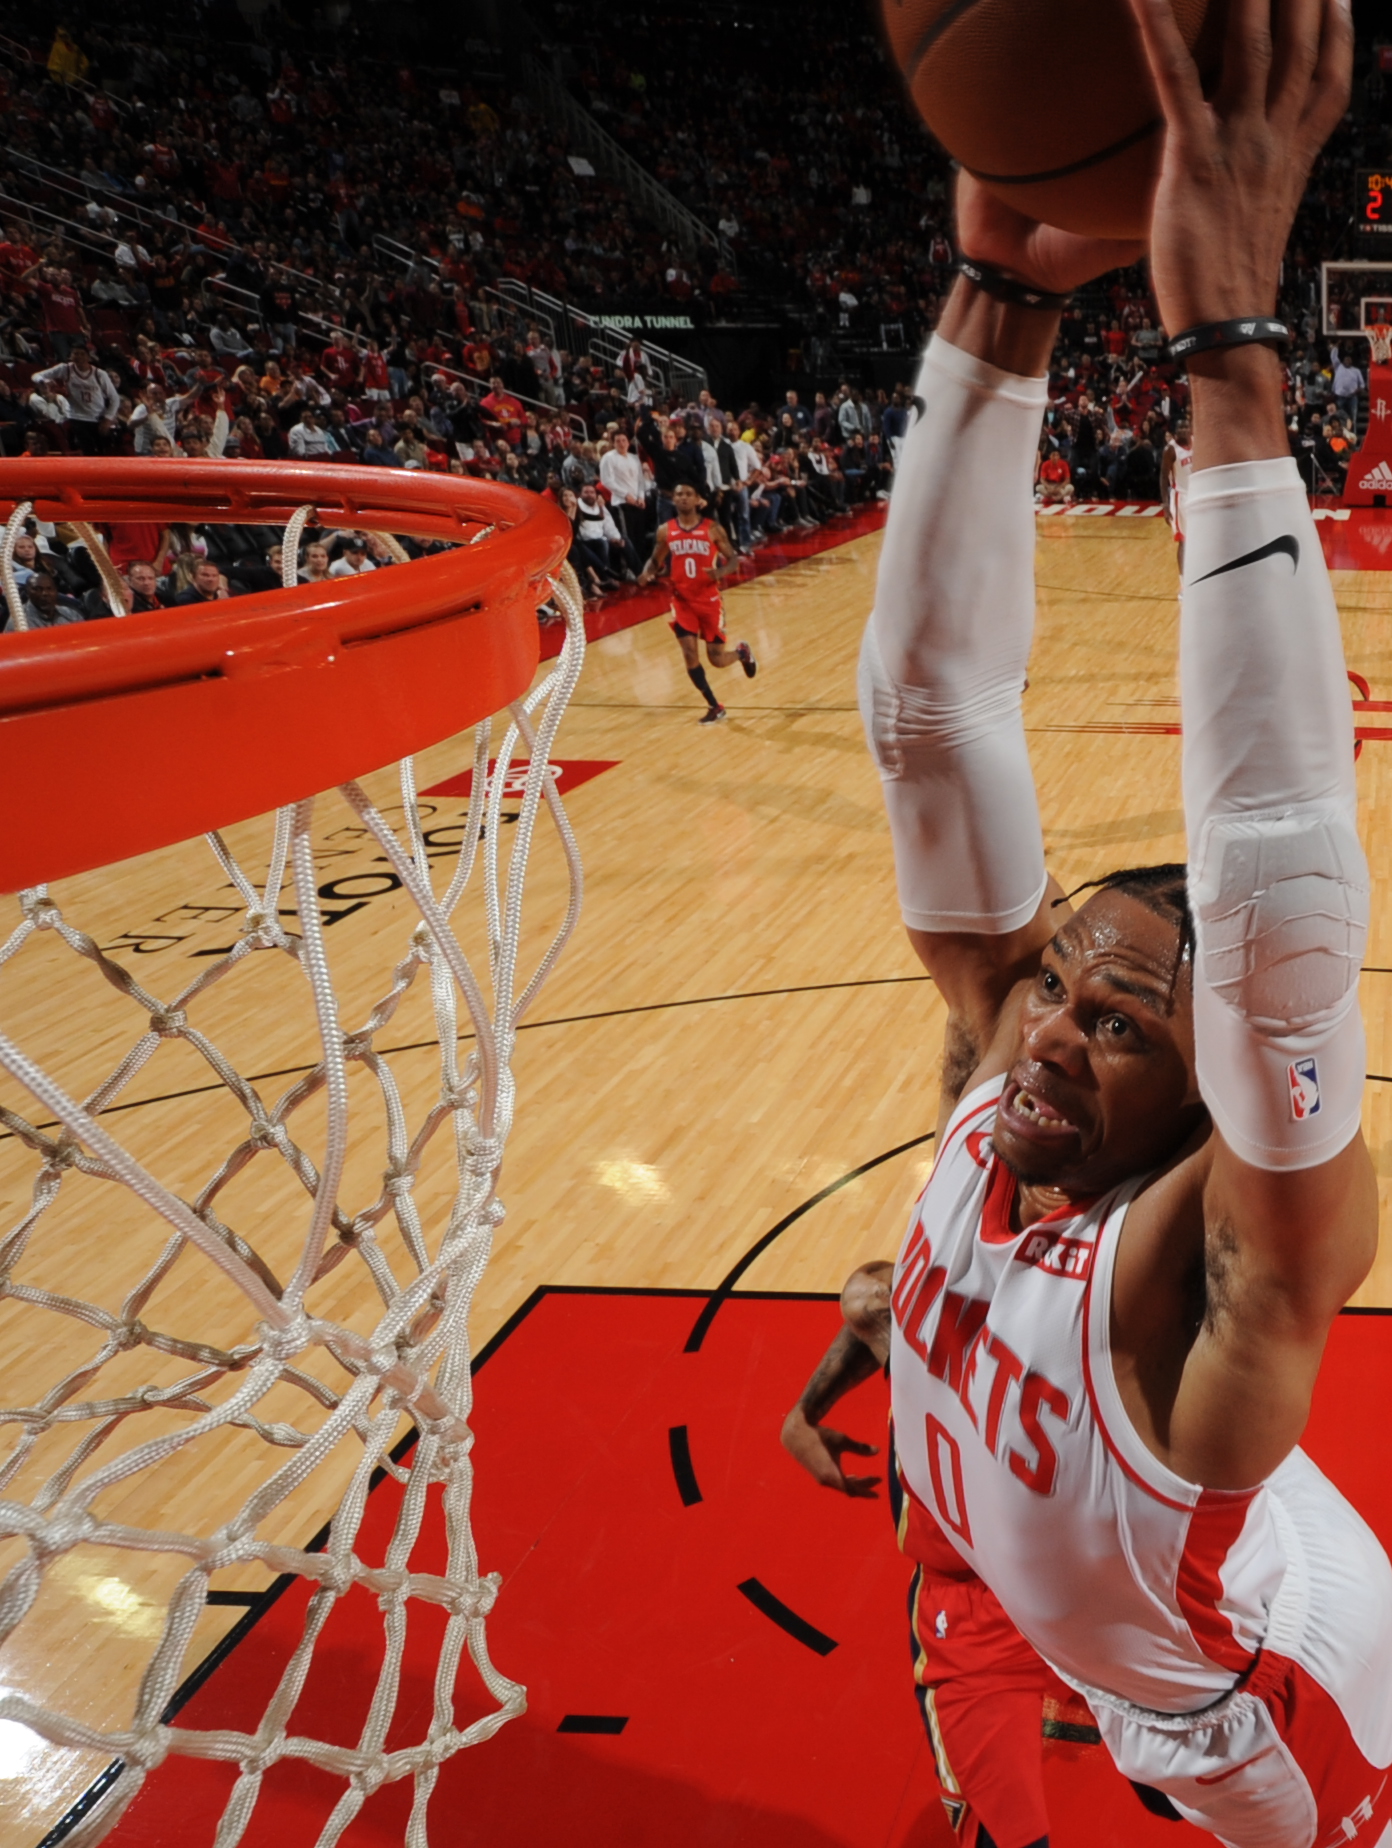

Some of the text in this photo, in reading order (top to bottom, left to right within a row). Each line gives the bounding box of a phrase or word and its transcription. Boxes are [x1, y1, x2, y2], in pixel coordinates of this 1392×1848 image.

[643, 315, 695, 329] TUNNEL
[668, 538, 711, 556] PELICANS
[684, 557, 697, 579] 0
[1024, 1236, 1090, 1275] RKiT
[925, 1411, 975, 1551] 0
